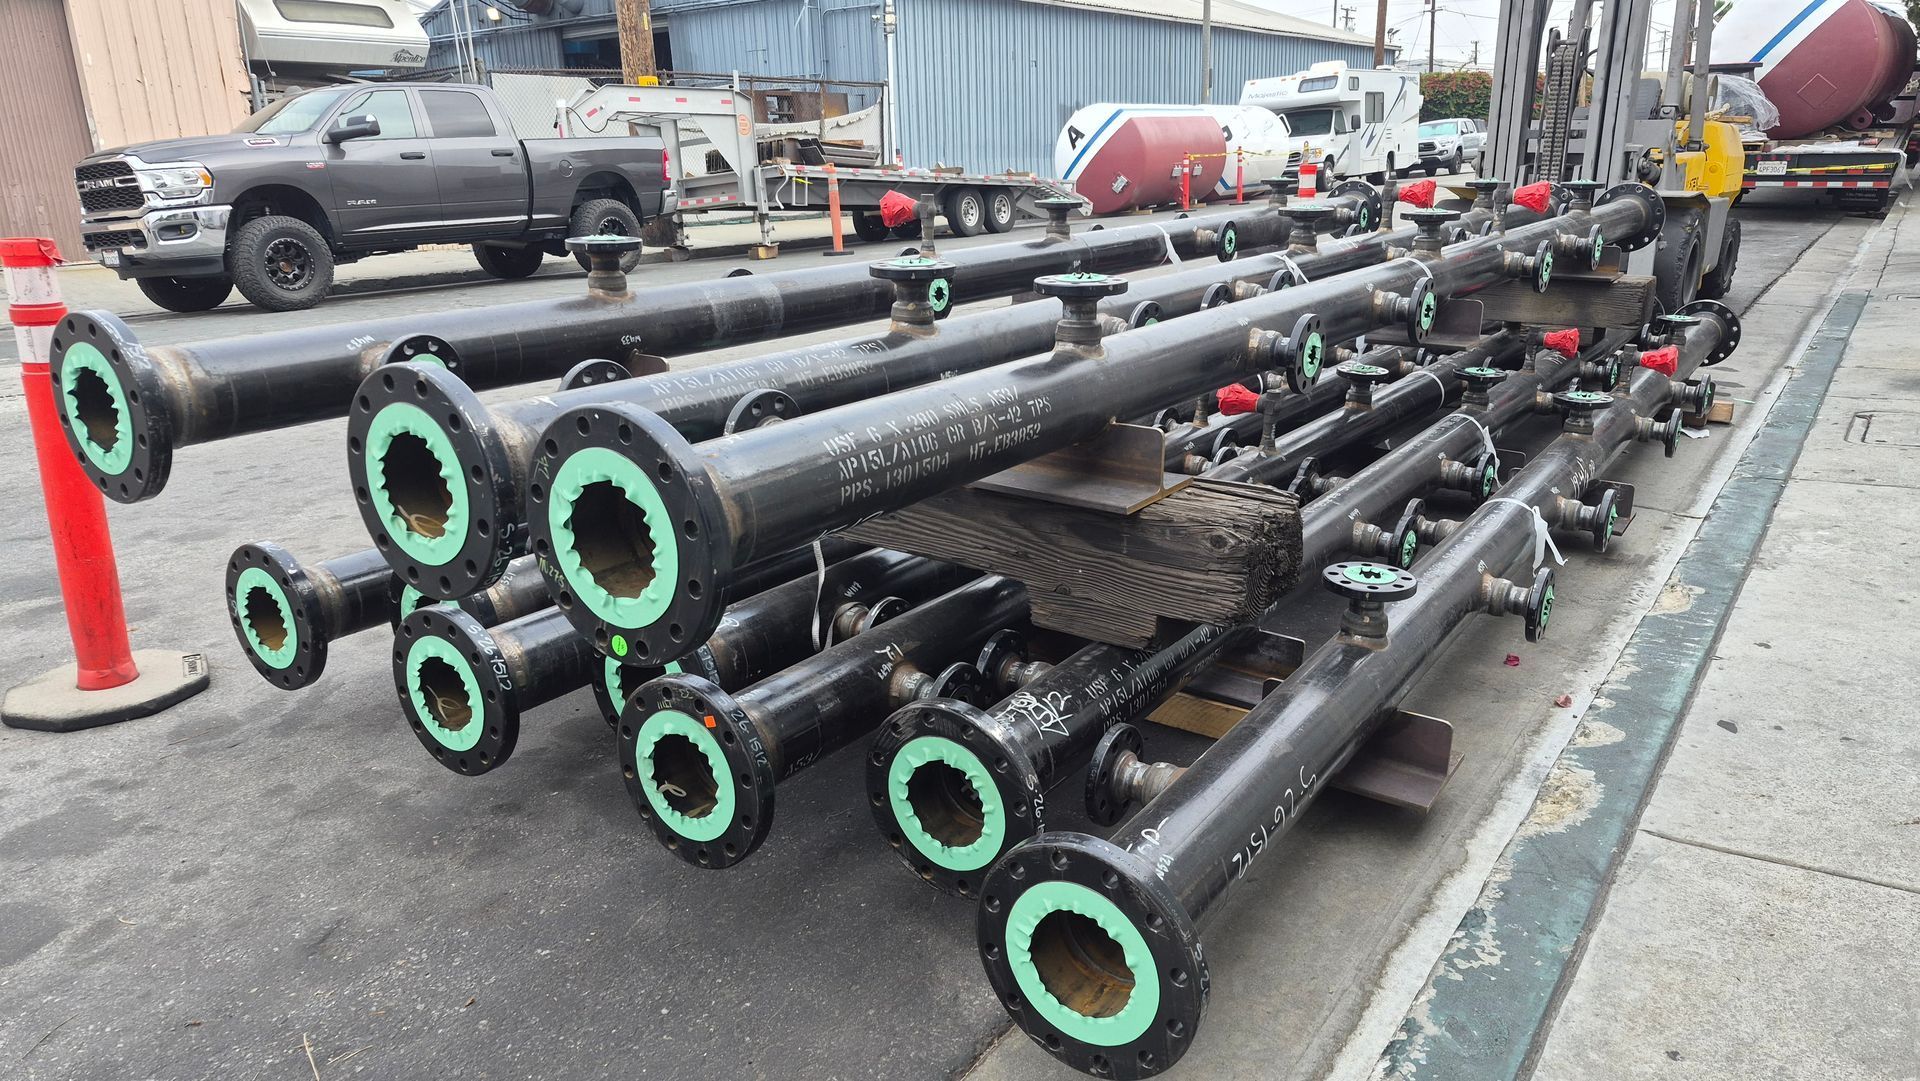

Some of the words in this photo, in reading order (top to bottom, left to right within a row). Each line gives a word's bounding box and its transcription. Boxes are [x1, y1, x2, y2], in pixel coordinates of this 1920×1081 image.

[1249, 90, 1288, 99] Majestic
[1067, 125, 1085, 150] A
[86, 180, 113, 189] RAM
[822, 431, 857, 457] USF
[943, 397, 983, 419] SMLS
[945, 423, 966, 444] GR
[972, 405, 1022, 436] B/X-42
[1027, 396, 1052, 417] TPS
[1085, 674, 1108, 699] USF
